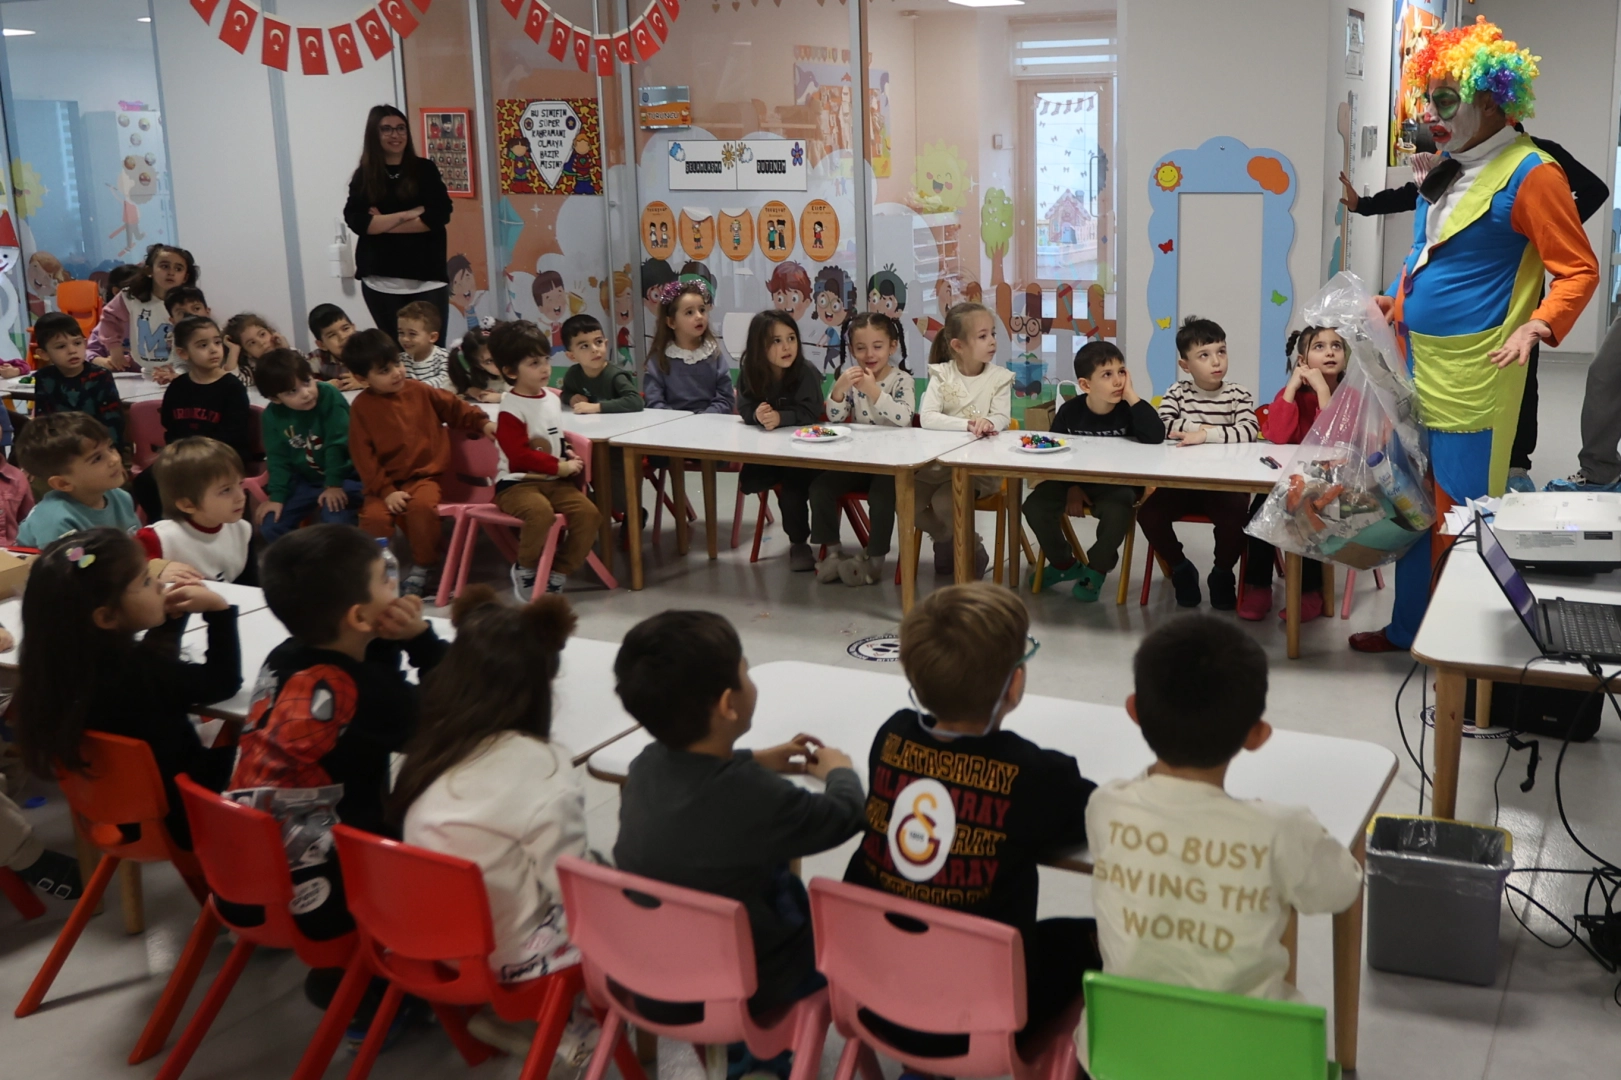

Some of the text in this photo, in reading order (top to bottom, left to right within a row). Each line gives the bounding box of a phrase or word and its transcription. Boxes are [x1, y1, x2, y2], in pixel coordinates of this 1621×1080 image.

[531, 109, 539, 117] BU
[538, 140, 563, 148] OLMAYA
[540, 150, 559, 158] HAZIR
[1109, 820, 1269, 871] TOO BUSY
[1093, 858, 1272, 914] SAVING THE
[1123, 905, 1235, 953] WORLD
